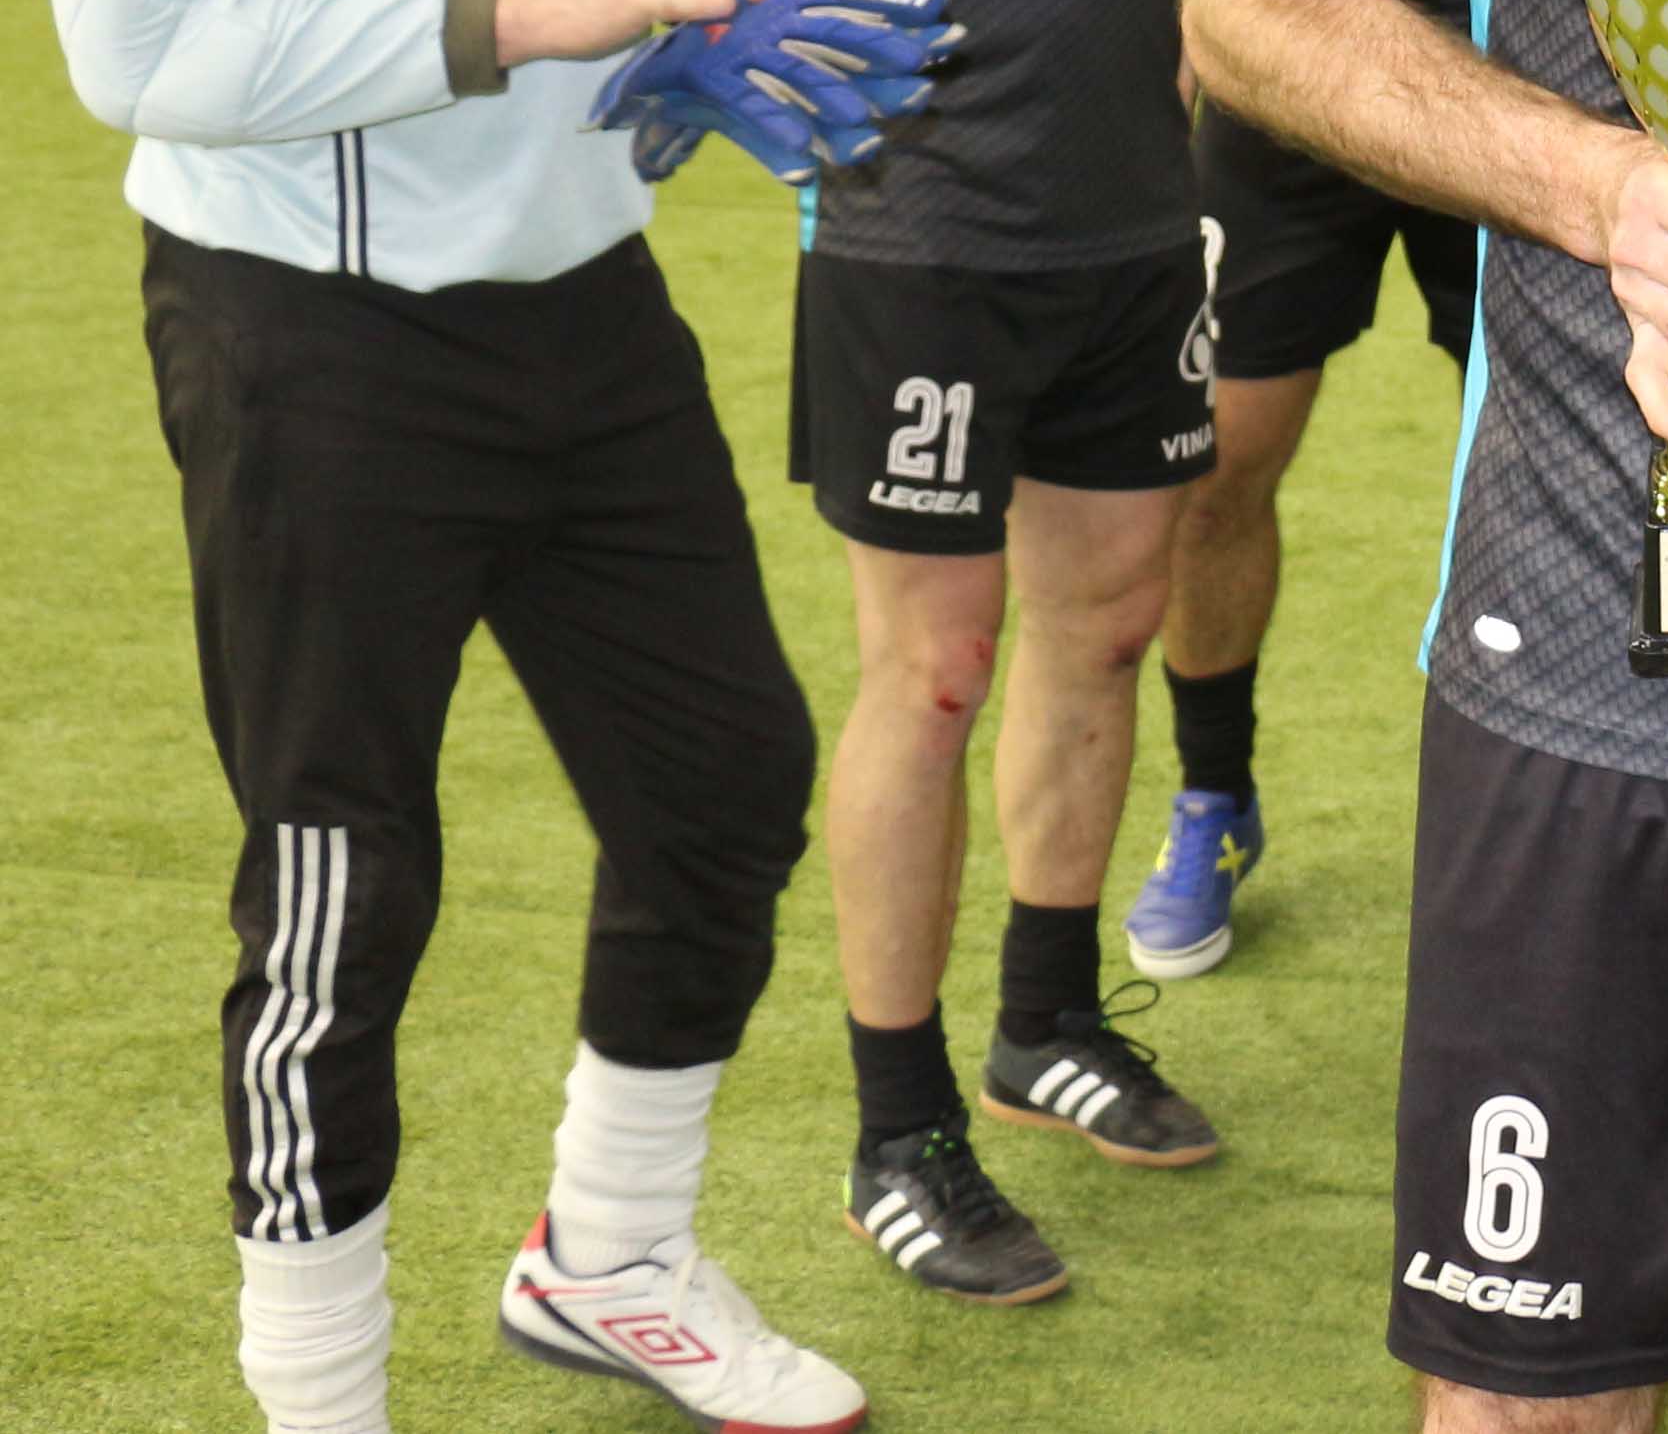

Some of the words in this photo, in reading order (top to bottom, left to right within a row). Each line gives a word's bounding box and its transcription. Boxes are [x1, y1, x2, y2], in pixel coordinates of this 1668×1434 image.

[887, 376, 975, 483] 21
[869, 480, 980, 515] LEGEA
[1464, 1094, 1549, 1263] 6
[1403, 1251, 1583, 1320] LEGEA
